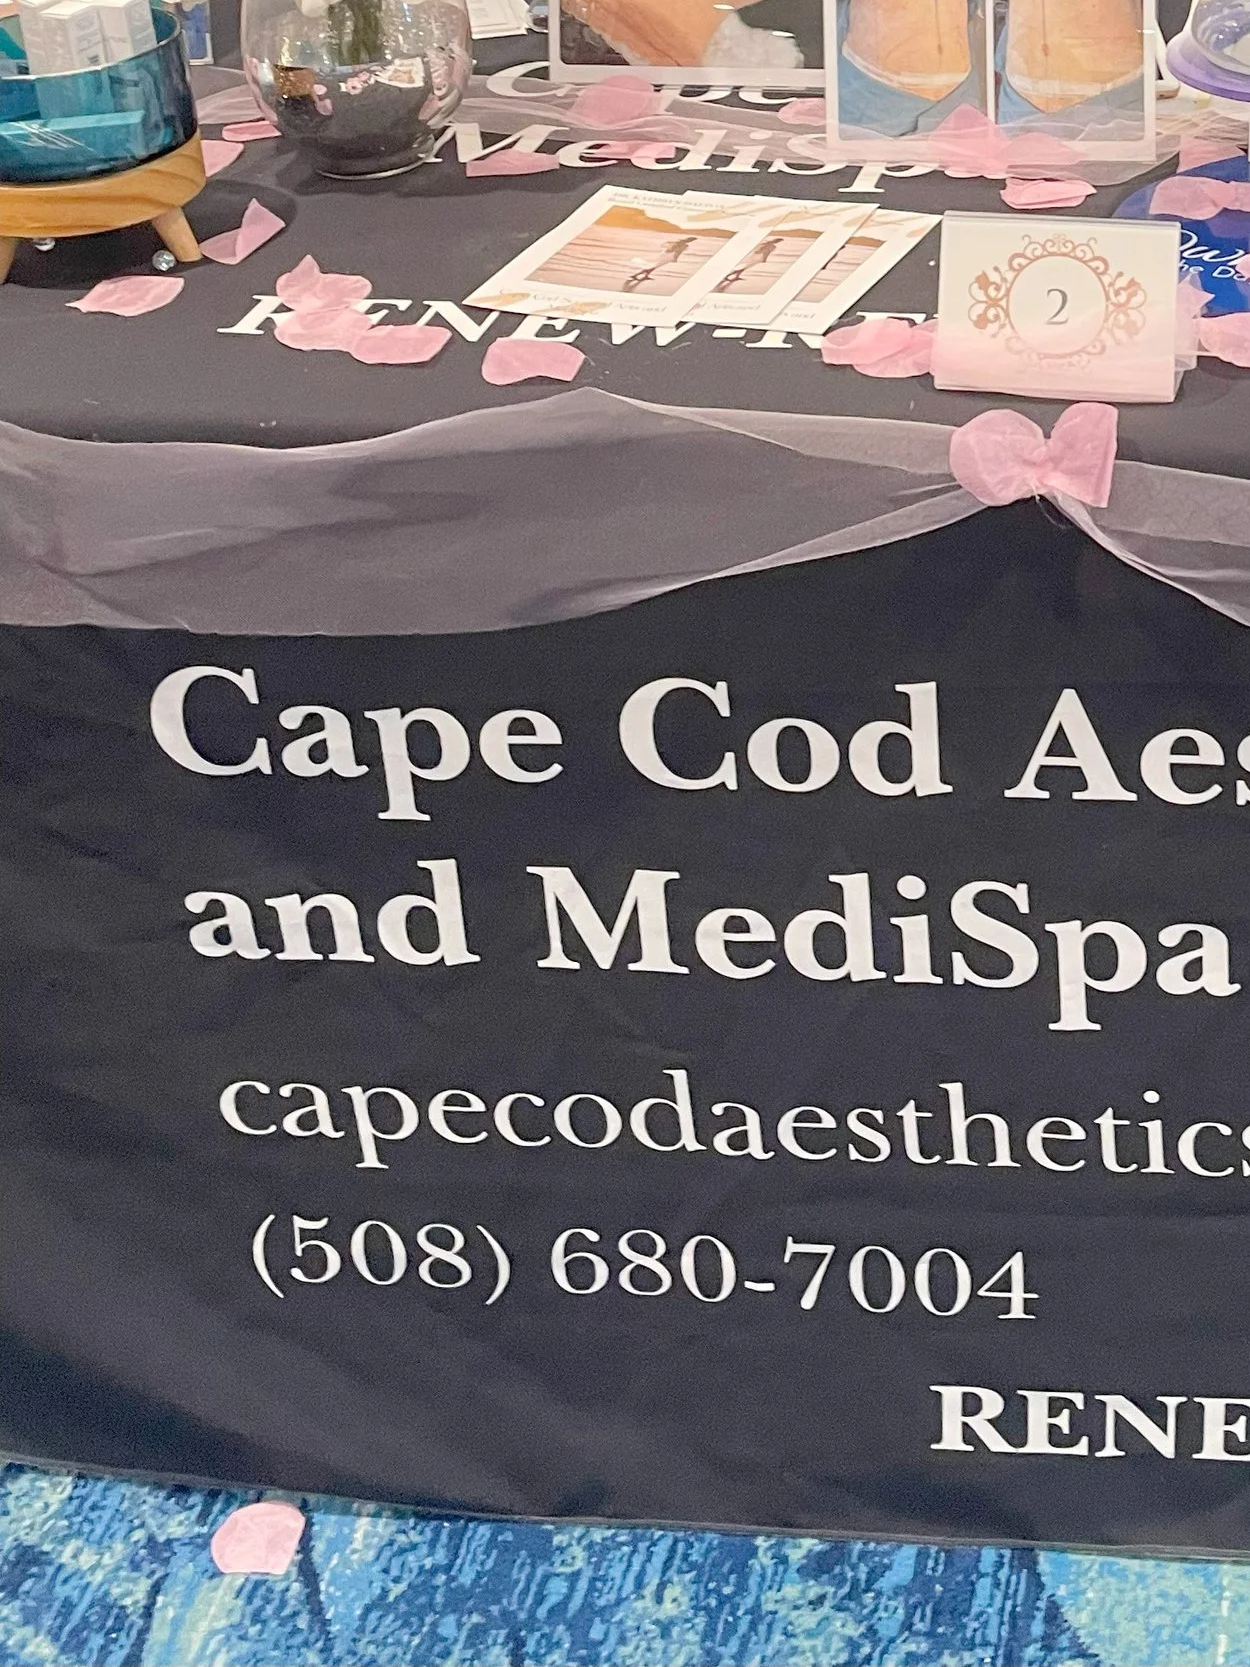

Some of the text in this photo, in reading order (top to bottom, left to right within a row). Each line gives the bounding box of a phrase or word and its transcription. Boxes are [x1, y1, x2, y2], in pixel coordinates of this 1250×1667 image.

[1045, 288, 1069, 326] 2
[150, 665, 563, 822] Cape
[618, 677, 954, 798] Cod
[184, 858, 1242, 1032] and MediSpa
[252, 1214, 1040, 1320] (508) 680-7004
